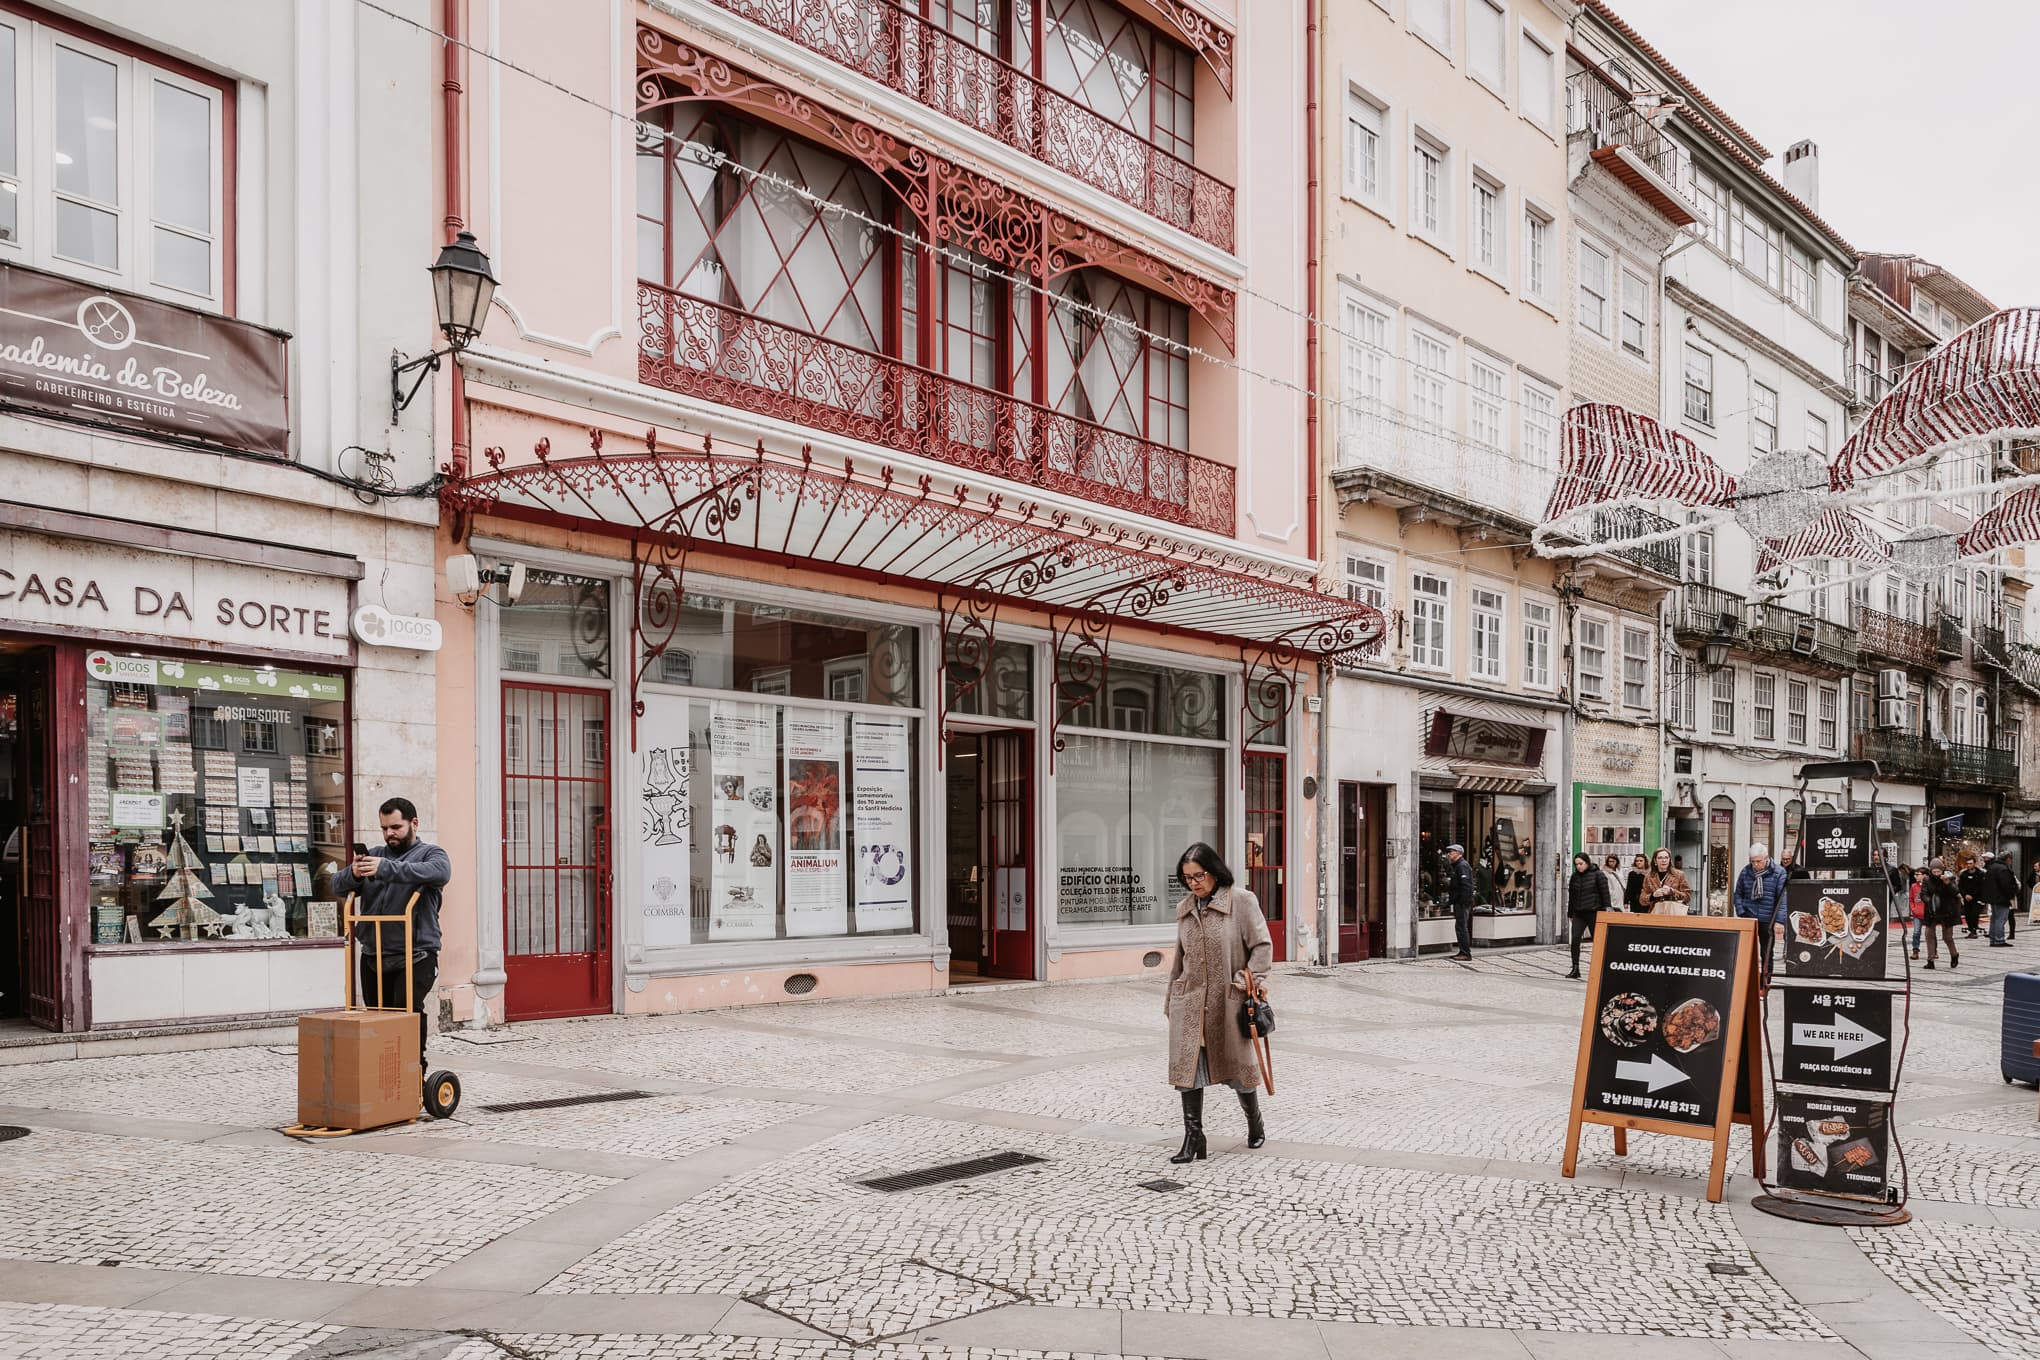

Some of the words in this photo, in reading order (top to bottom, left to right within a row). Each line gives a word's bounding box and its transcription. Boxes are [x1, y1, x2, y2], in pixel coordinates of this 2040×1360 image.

[116, 357, 152, 390] de
[152, 367, 242, 411] Beleza
[35, 379, 112, 406] CABELEIREIRO
[116, 398, 123, 409] &
[127, 398, 176, 419] ESTÉTICA
[0, 569, 109, 612] CASA
[135, 586, 193, 621] DA
[216, 597, 330, 638] SORTE
[390, 618, 433, 636] JOGOS
[115, 661, 150, 673] JOGOS
[257, 709, 292, 724] SORTE
[1817, 838, 1857, 850] SEOUL
[791, 859, 838, 868] ANIMALIUM
[1060, 872, 1101, 886] EDIFÍCIO
[1104, 875, 1140, 885] CHIADO
[1060, 886, 1092, 897] COLEÇÃO
[1061, 898, 1088, 906] PINTURA
[1094, 904, 1128, 912] BIBLIOTECA
[644, 908, 685, 917] COIMBRA
[1627, 943, 1662, 955] SEOUL
[1662, 946, 1711, 957] CHICKEN
[1609, 961, 1665, 974] GANGNAM
[1666, 965, 1701, 977] TABLE
[1702, 968, 1726, 980] BBQ
[1812, 995, 1832, 1008] 서울
[1834, 995, 1856, 1008] 치킨
[1803, 1029, 1817, 1039] WE
[1818, 1030, 1836, 1040] ARE
[1837, 1031, 1864, 1042] HERE!
[1800, 1062, 1820, 1072] PRAÇA
[1820, 1064, 1830, 1072] DO
[1830, 1062, 1862, 1074] COMÉRCIO
[1807, 1103, 1832, 1111] KOREAN
[1832, 1104, 1857, 1113] SNACKS
